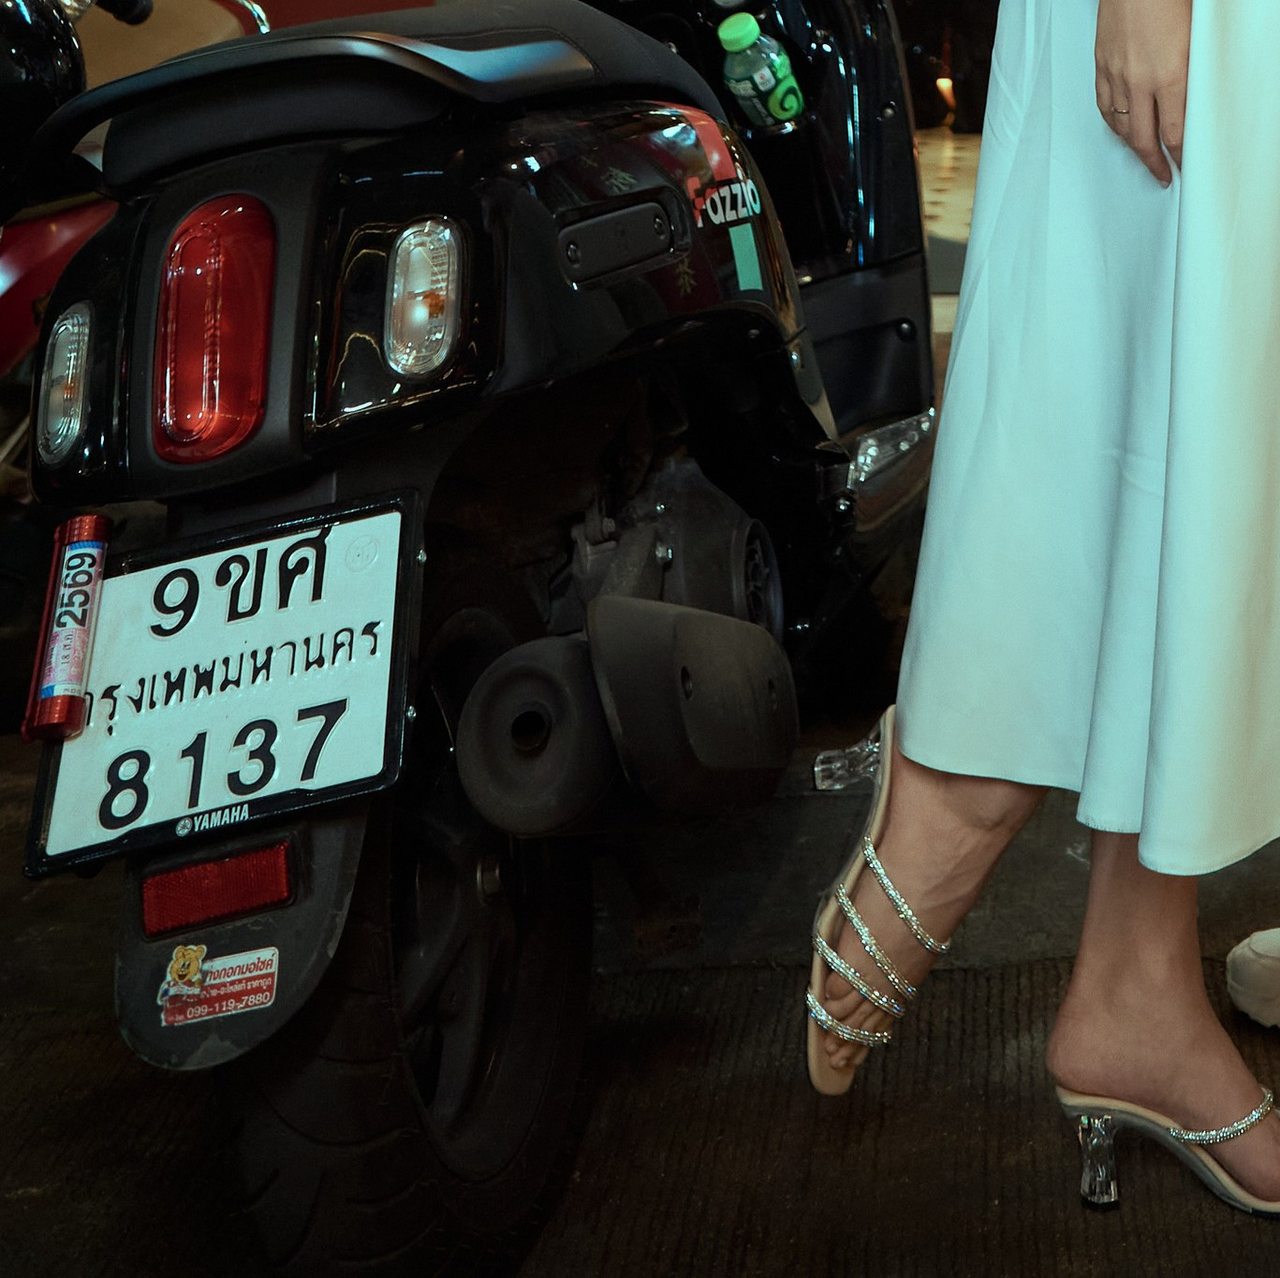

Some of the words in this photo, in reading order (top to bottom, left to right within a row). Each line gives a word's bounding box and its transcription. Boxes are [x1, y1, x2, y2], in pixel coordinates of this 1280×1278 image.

[55, 552, 98, 630] 2569
[98, 698, 350, 832] 8137
[193, 803, 250, 833] YAMAHA
[186, 991, 271, 1019] 099-119-7880
